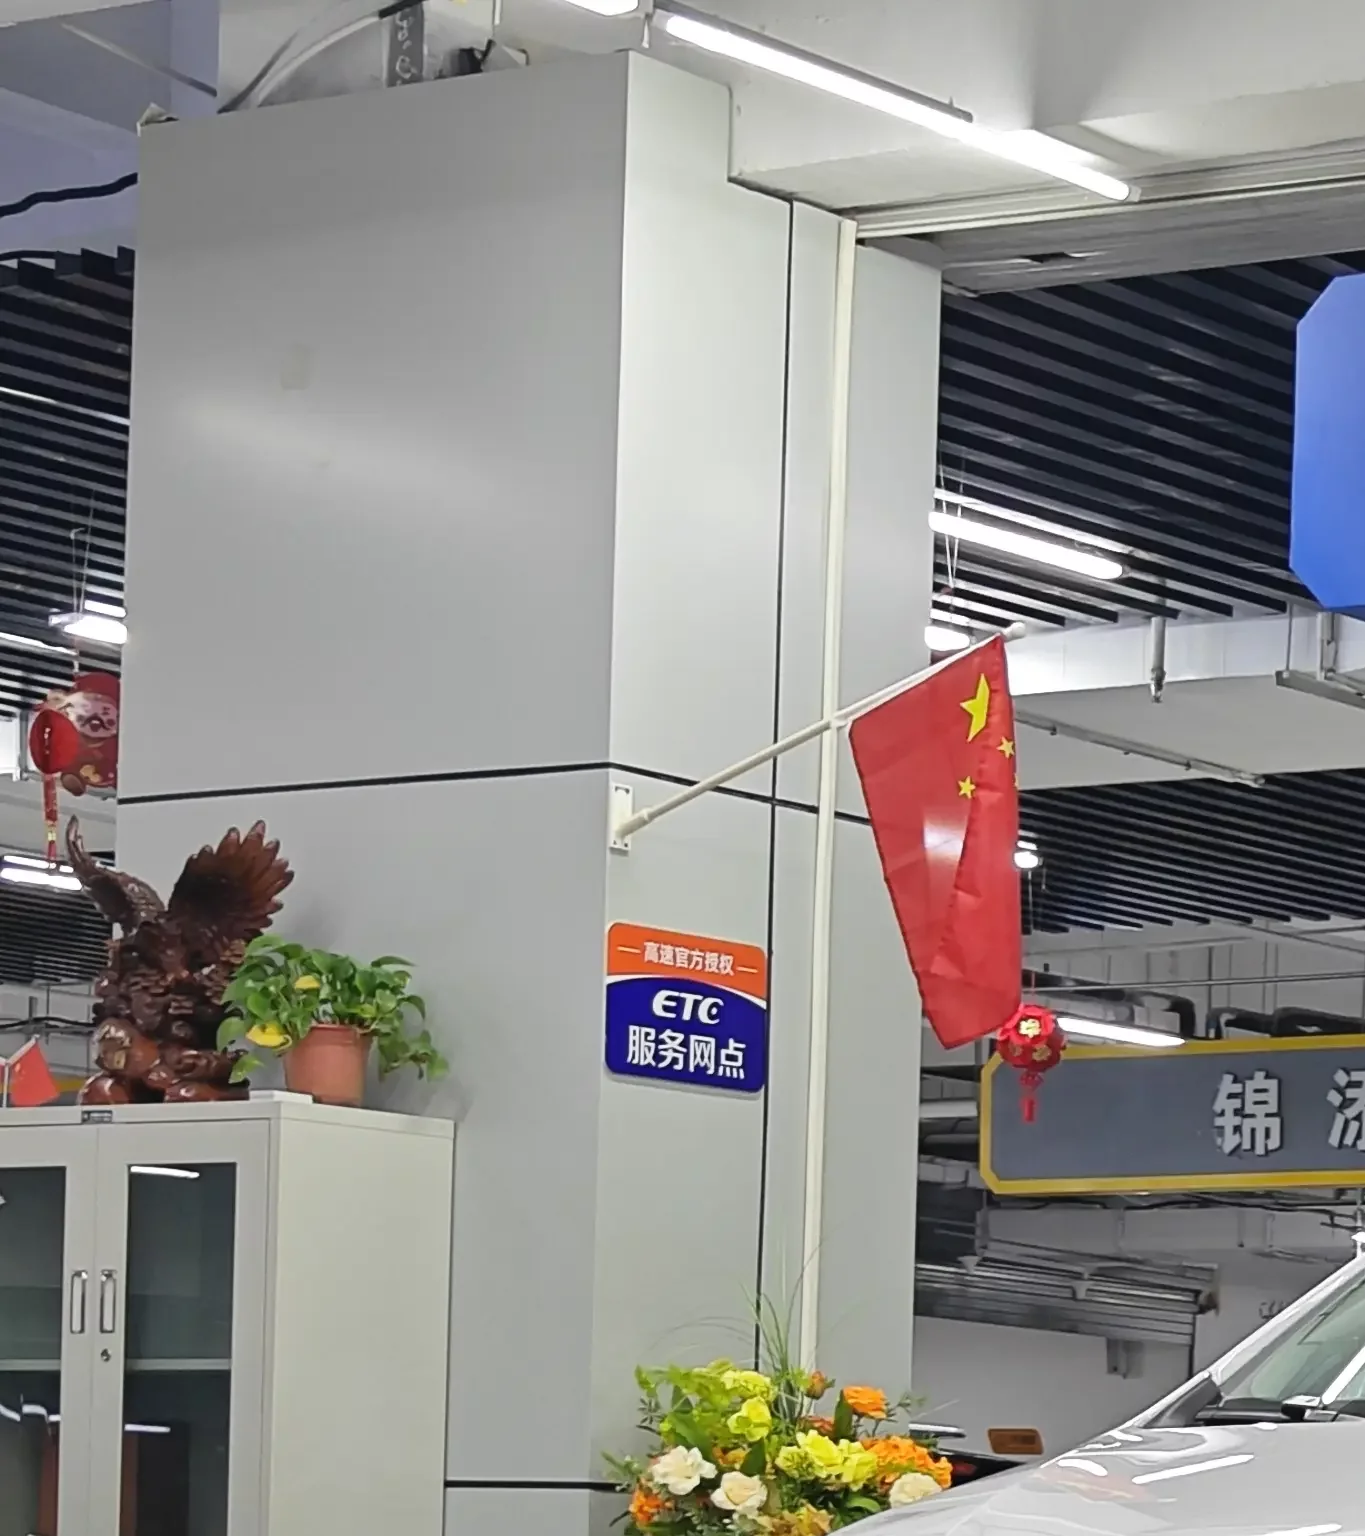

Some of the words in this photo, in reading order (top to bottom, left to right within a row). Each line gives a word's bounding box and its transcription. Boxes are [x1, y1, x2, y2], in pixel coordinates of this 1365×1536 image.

[643, 941, 735, 976] 高速官方授权
[652, 989, 724, 1025] ETC
[627, 1024, 746, 1080] 服务网点
